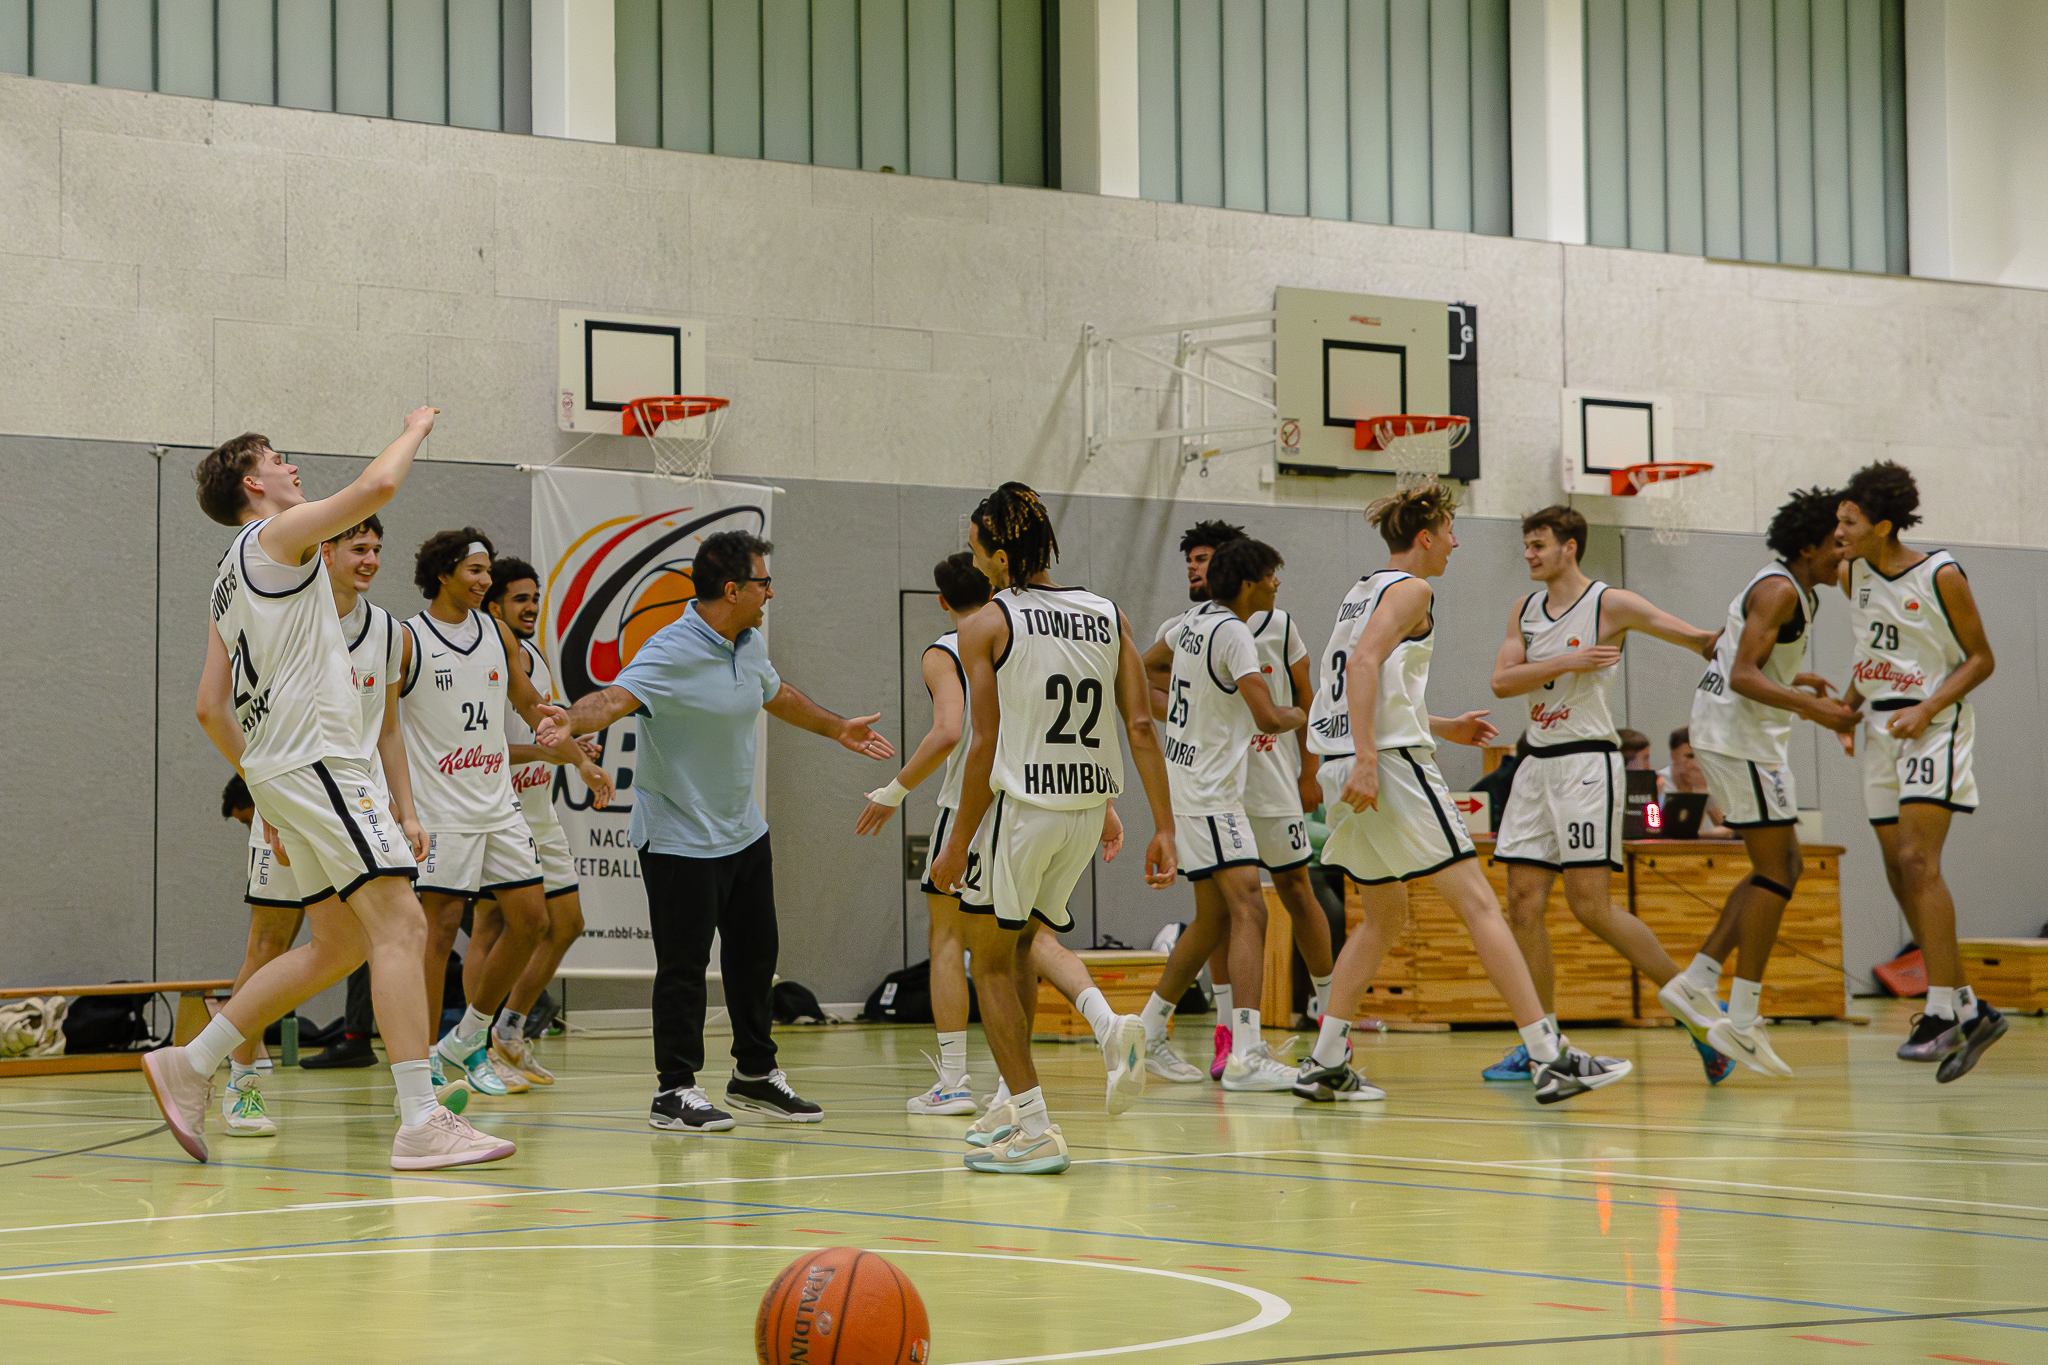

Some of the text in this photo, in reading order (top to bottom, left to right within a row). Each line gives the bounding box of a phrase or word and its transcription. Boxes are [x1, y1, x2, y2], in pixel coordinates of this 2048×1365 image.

[1020, 608, 1112, 644] TOWERS
[1870, 621, 1900, 651] 29
[1852, 659, 1927, 692] Kellogg's
[1045, 674, 1103, 748] 22
[1168, 673, 1191, 728] 25
[461, 701, 489, 732] 24
[438, 744, 504, 775] Kellogg
[1905, 757, 1935, 786] 29
[529, 837, 541, 864] 2
[1569, 822, 1595, 849] 30
[789, 1265, 837, 1365] SPALDIN
